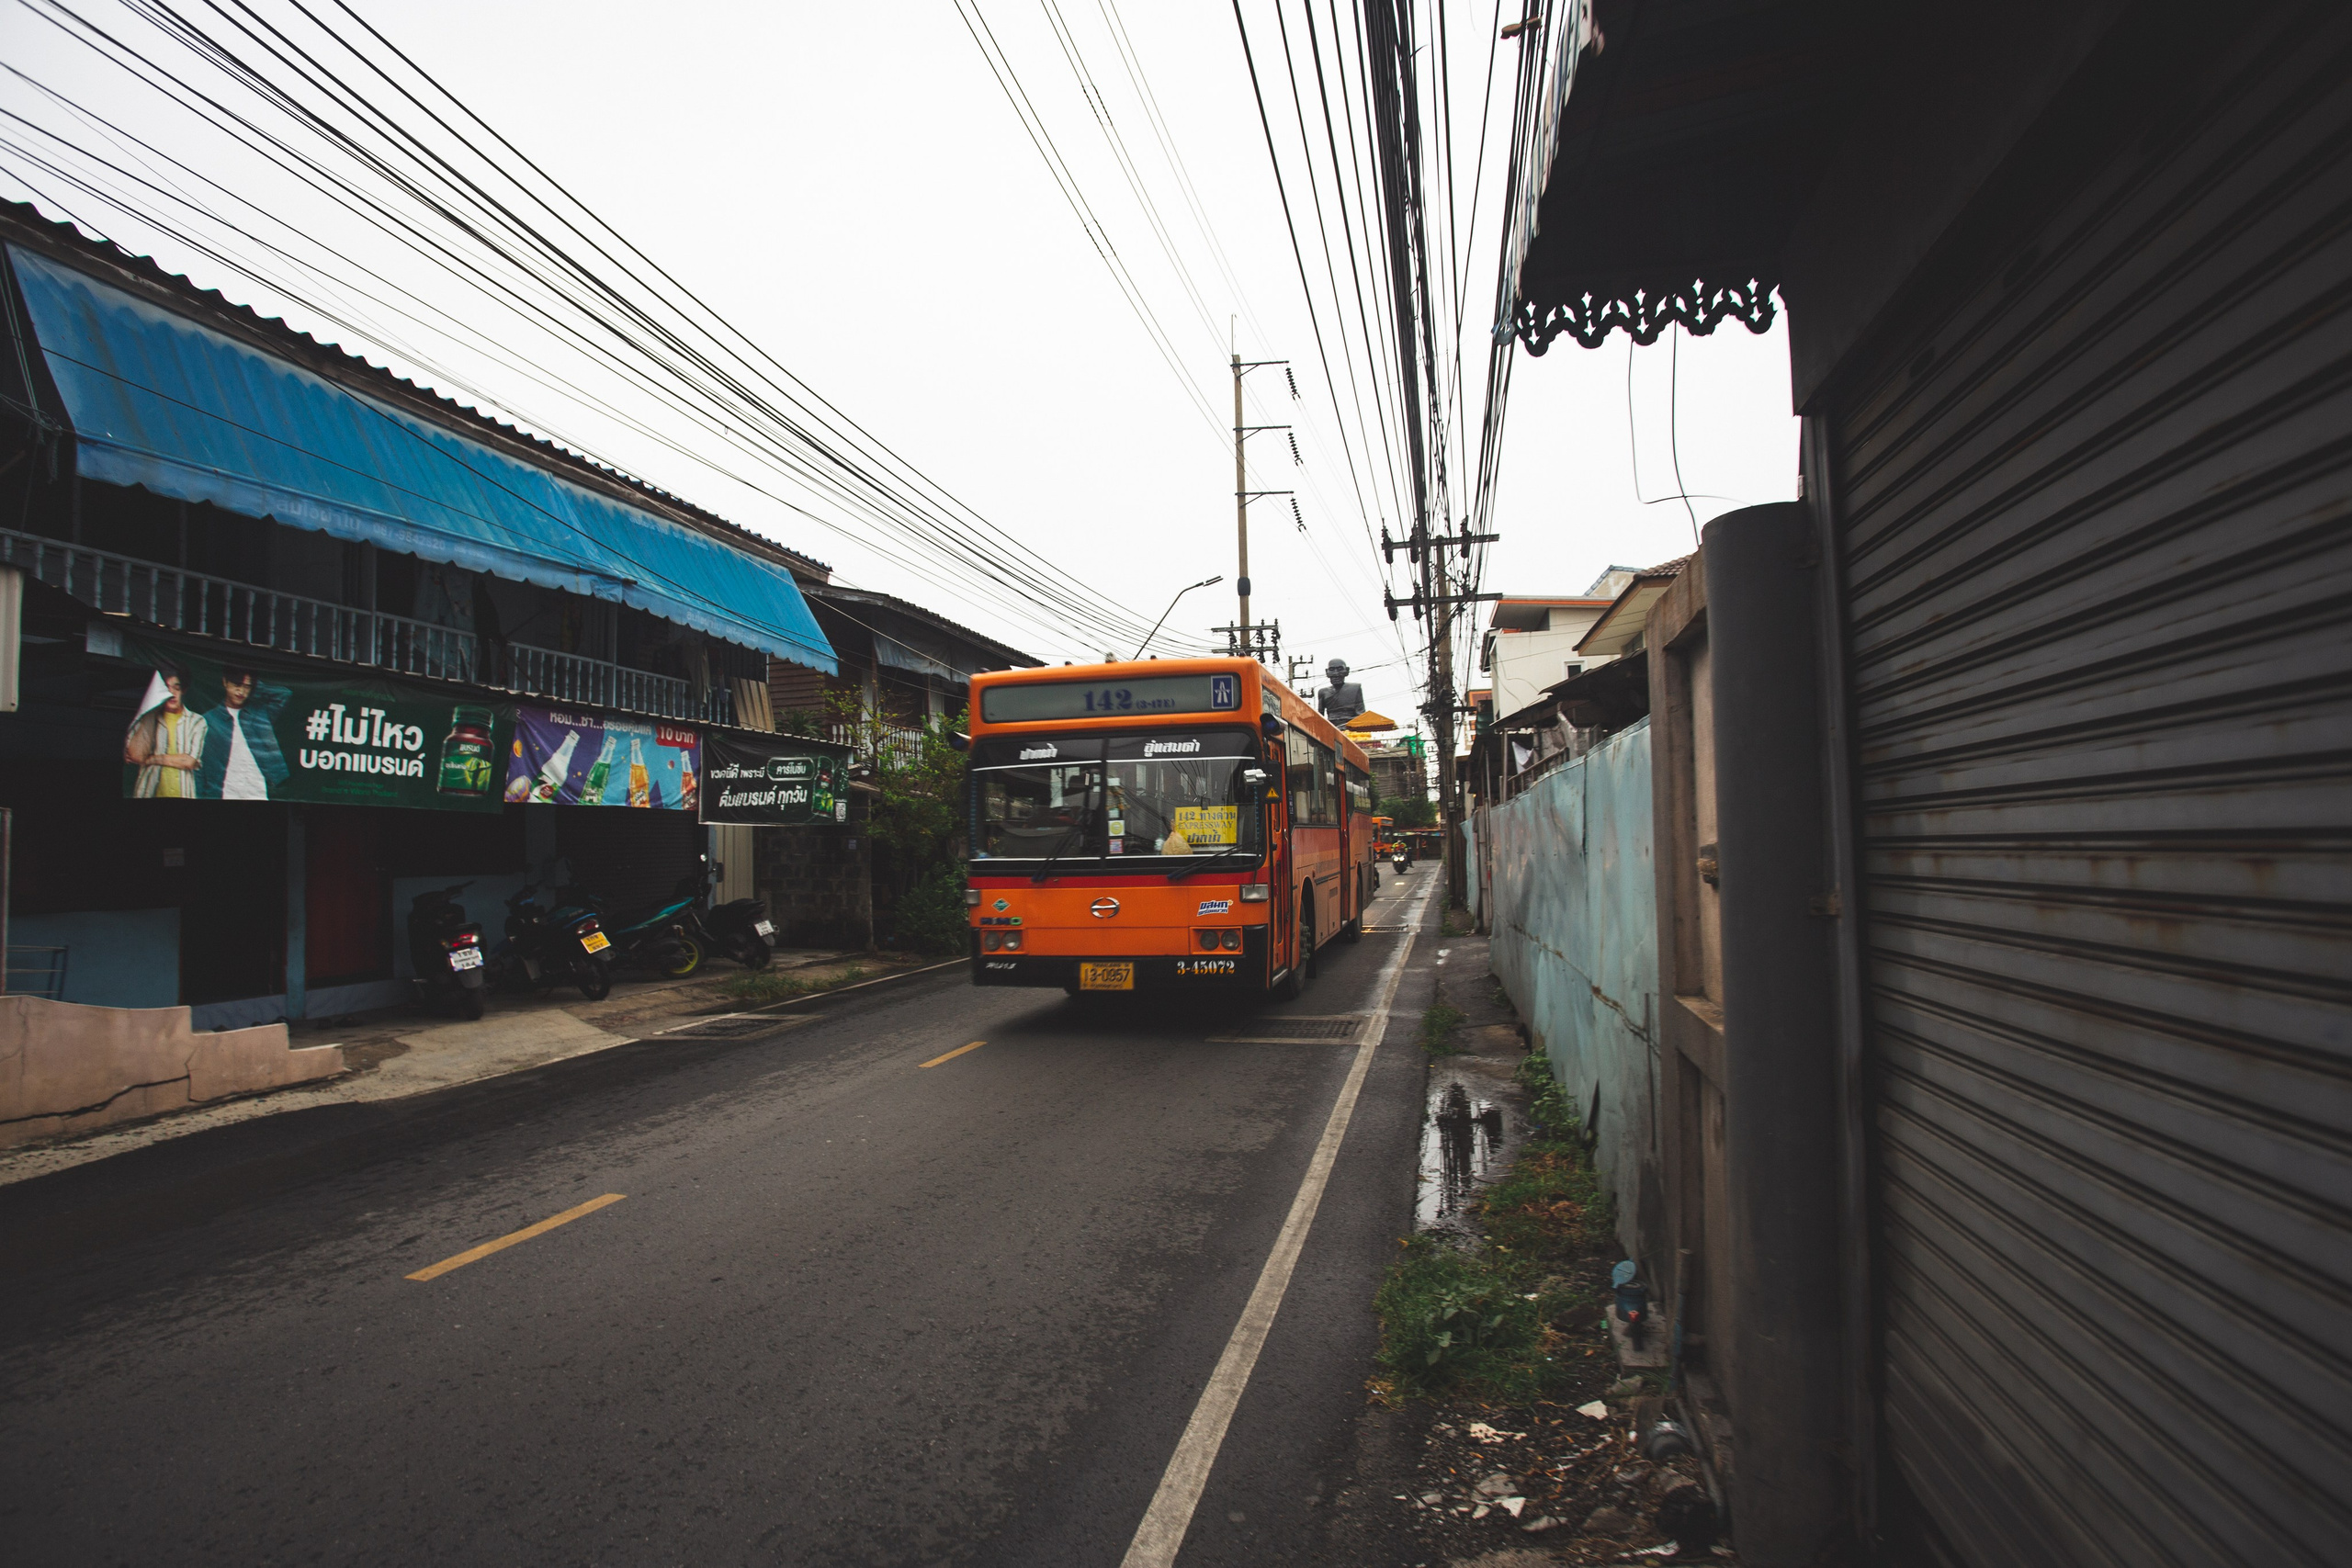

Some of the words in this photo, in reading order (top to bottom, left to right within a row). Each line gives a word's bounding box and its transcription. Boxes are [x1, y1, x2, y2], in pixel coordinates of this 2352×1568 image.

[1083, 689, 1133, 711] 142
[305, 703, 424, 751] #ไม่ไหว
[659, 726, 673, 740] 10
[300, 748, 426, 778] บอกแบรนด์
[718, 784, 778, 807] ดื่มแบรนด์
[777, 785, 808, 810] ทุกวัน
[1179, 810, 1195, 821] 142
[1200, 807, 1236, 820] ทางด่วน
[1178, 821, 1234, 830] EXPRESSWAY
[1187, 829, 1222, 843] ปากน้ำ
[1084, 967, 1131, 982] 13-0957
[1177, 960, 1235, 976] 3-45072
